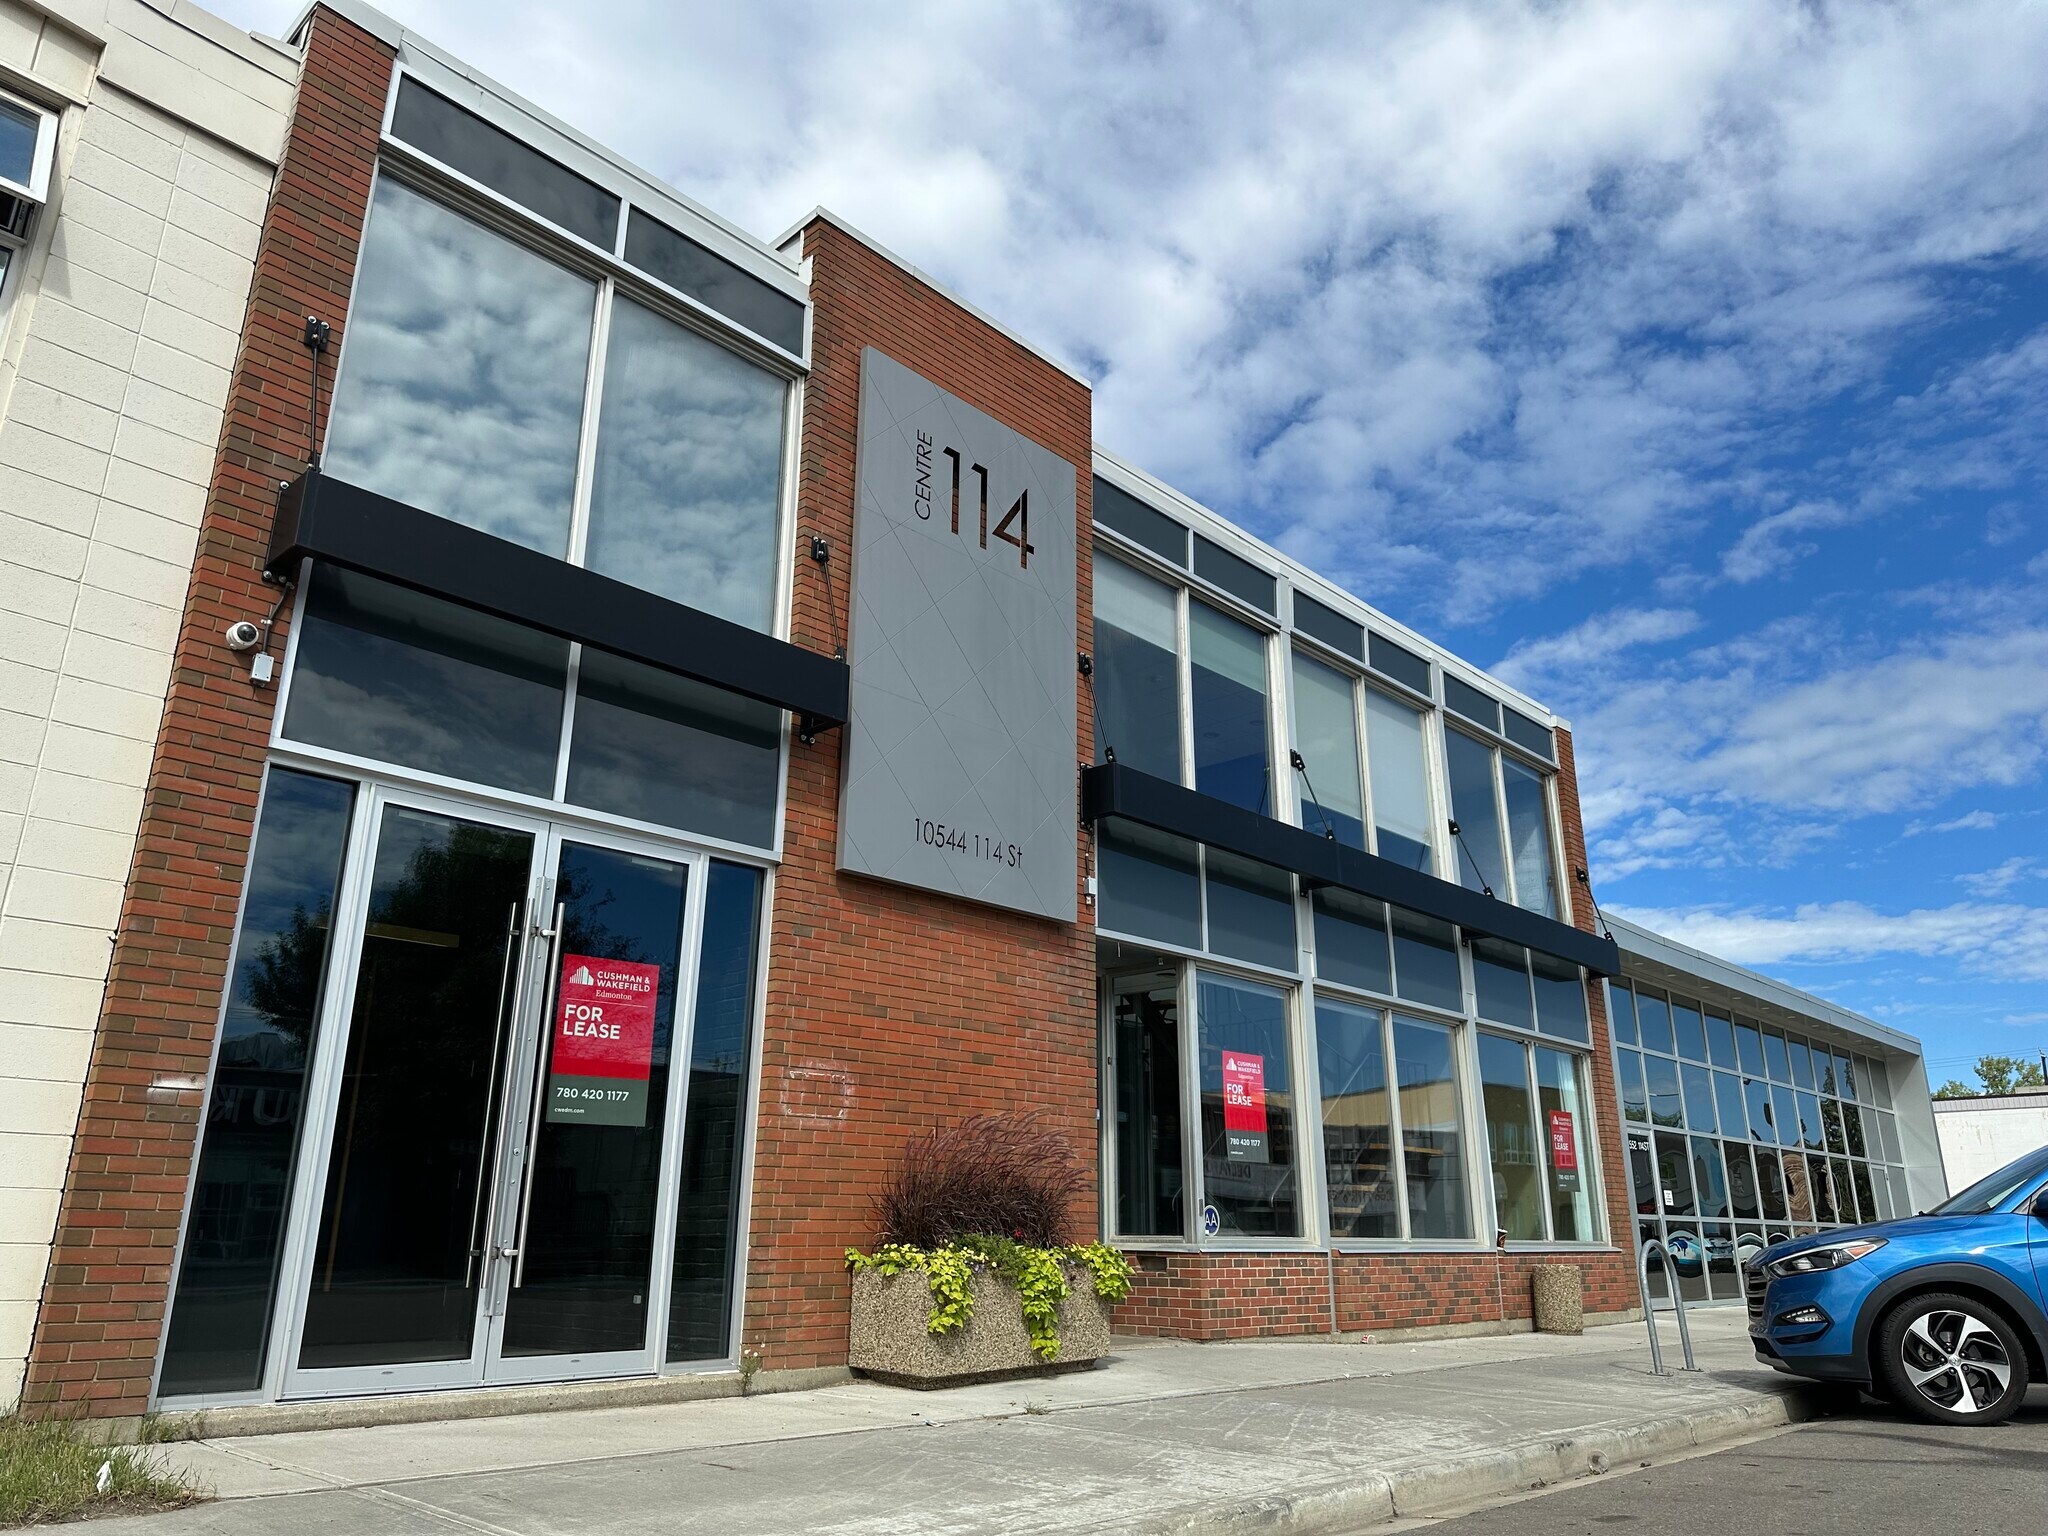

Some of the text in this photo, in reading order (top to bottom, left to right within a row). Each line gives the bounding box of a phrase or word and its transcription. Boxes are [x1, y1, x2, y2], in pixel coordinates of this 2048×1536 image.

[914, 429, 932, 521] CENTRE
[943, 446, 1034, 570] 114
[915, 818, 1023, 869] 10544 114 St
[597, 971, 650, 985] CUSHMAN &
[597, 979, 650, 992] WAKEFIELD
[595, 989, 632, 1000] Edmonton
[565, 1004, 603, 1021] FOR
[563, 1020, 621, 1039] LEASE
[556, 1087, 629, 1101] 780 420 1177
[1226, 1083, 1244, 1095] FOR
[1227, 1093, 1252, 1106] LEASE
[1553, 1134, 1564, 1142] FOR
[1554, 1142, 1569, 1151] LEASE
